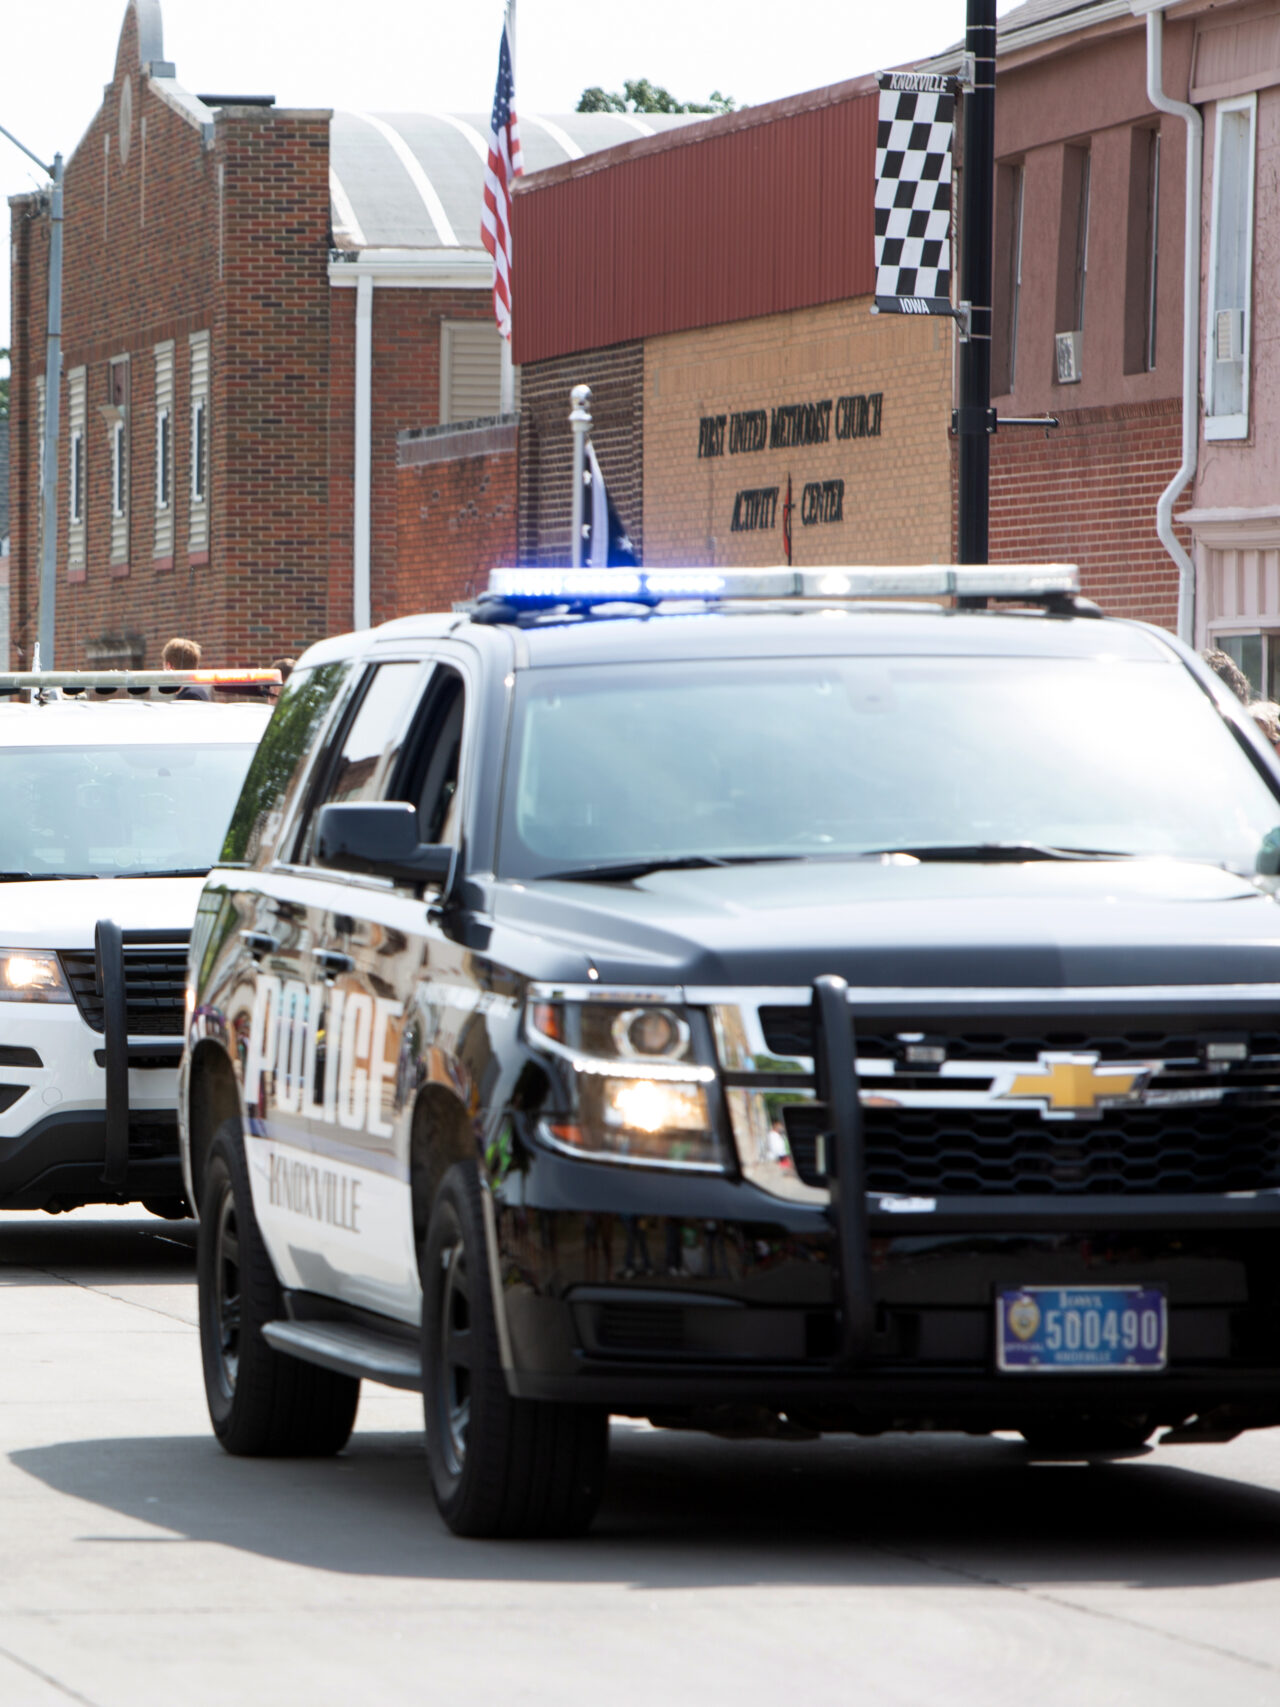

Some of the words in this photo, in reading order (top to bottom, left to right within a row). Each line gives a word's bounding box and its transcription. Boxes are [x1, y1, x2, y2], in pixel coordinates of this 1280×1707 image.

[889, 73, 949, 93] KNOXVILLE
[899, 297, 931, 314] IOWA
[698, 414, 727, 459] FIRST
[729, 409, 768, 455] UNITED
[769, 399, 833, 450] METHODIST
[835, 392, 884, 441] CHURCH
[730, 486, 780, 532] ACTIVITY
[801, 479, 845, 526] CENTER
[245, 974, 404, 1138] POLICE
[269, 1153, 362, 1234] KNOXVILLE
[1045, 1309, 1159, 1350] 500490
